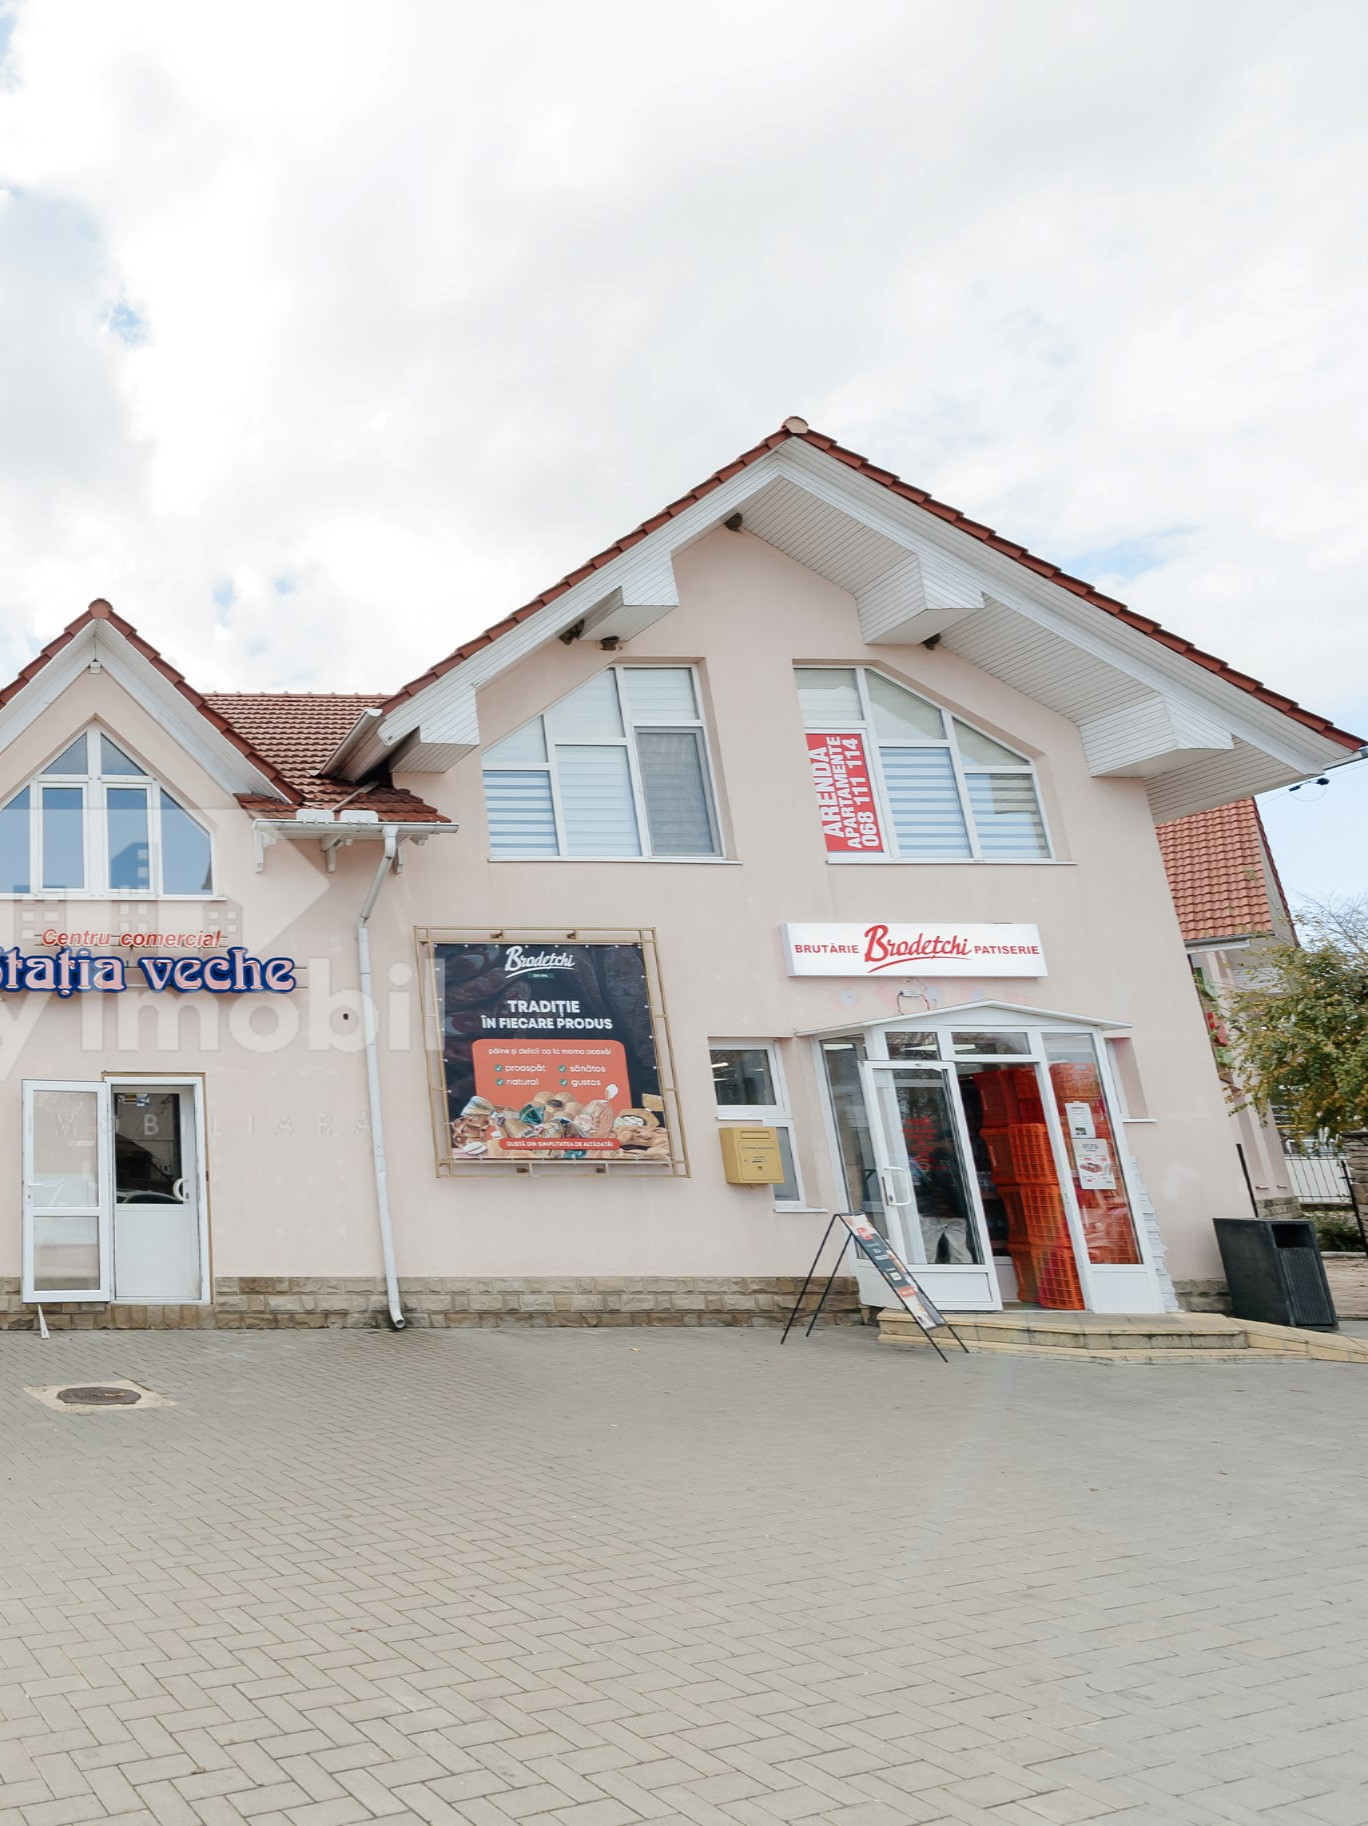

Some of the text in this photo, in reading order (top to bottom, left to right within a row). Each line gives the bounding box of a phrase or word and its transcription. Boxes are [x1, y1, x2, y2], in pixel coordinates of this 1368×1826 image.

[808, 747, 845, 838] ARENDA
[826, 736, 862, 848] APARTAMENTE
[842, 738, 880, 847] 068 111 114
[42, 928, 222, 947] Centru comercial
[794, 942, 860, 954] BRUTĂRIE
[974, 945, 1040, 955] PATISERIE
[138, 947, 296, 993] veche
[507, 1000, 581, 1018] TRADIȚIE
[480, 1014, 613, 1030] ÎN FIECARE PRODUS
[506, 1078, 539, 1086] natural
[571, 1079, 601, 1088] gustos
